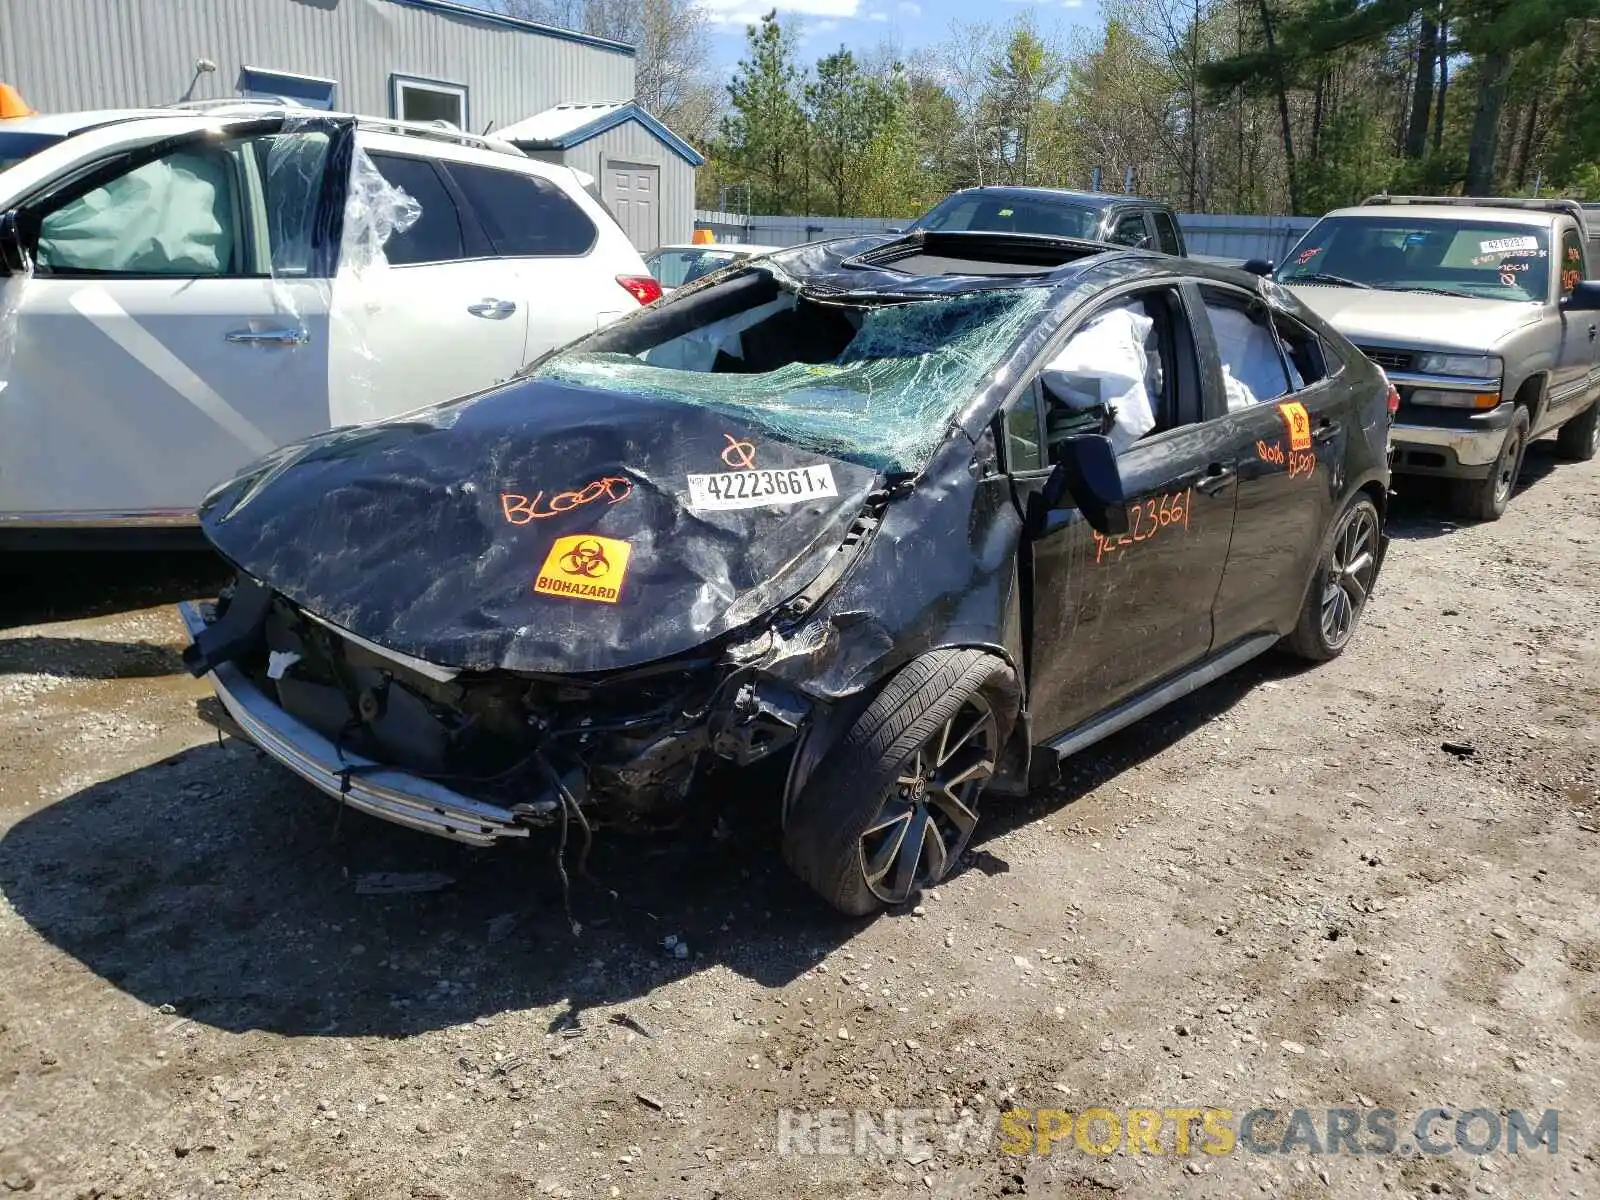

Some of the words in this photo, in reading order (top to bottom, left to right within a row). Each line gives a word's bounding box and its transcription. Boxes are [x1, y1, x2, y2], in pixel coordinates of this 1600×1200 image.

[707, 469, 814, 500] 42223661
[502, 477, 631, 525] BLOOD
[537, 576, 617, 600] BIOHAZARD
